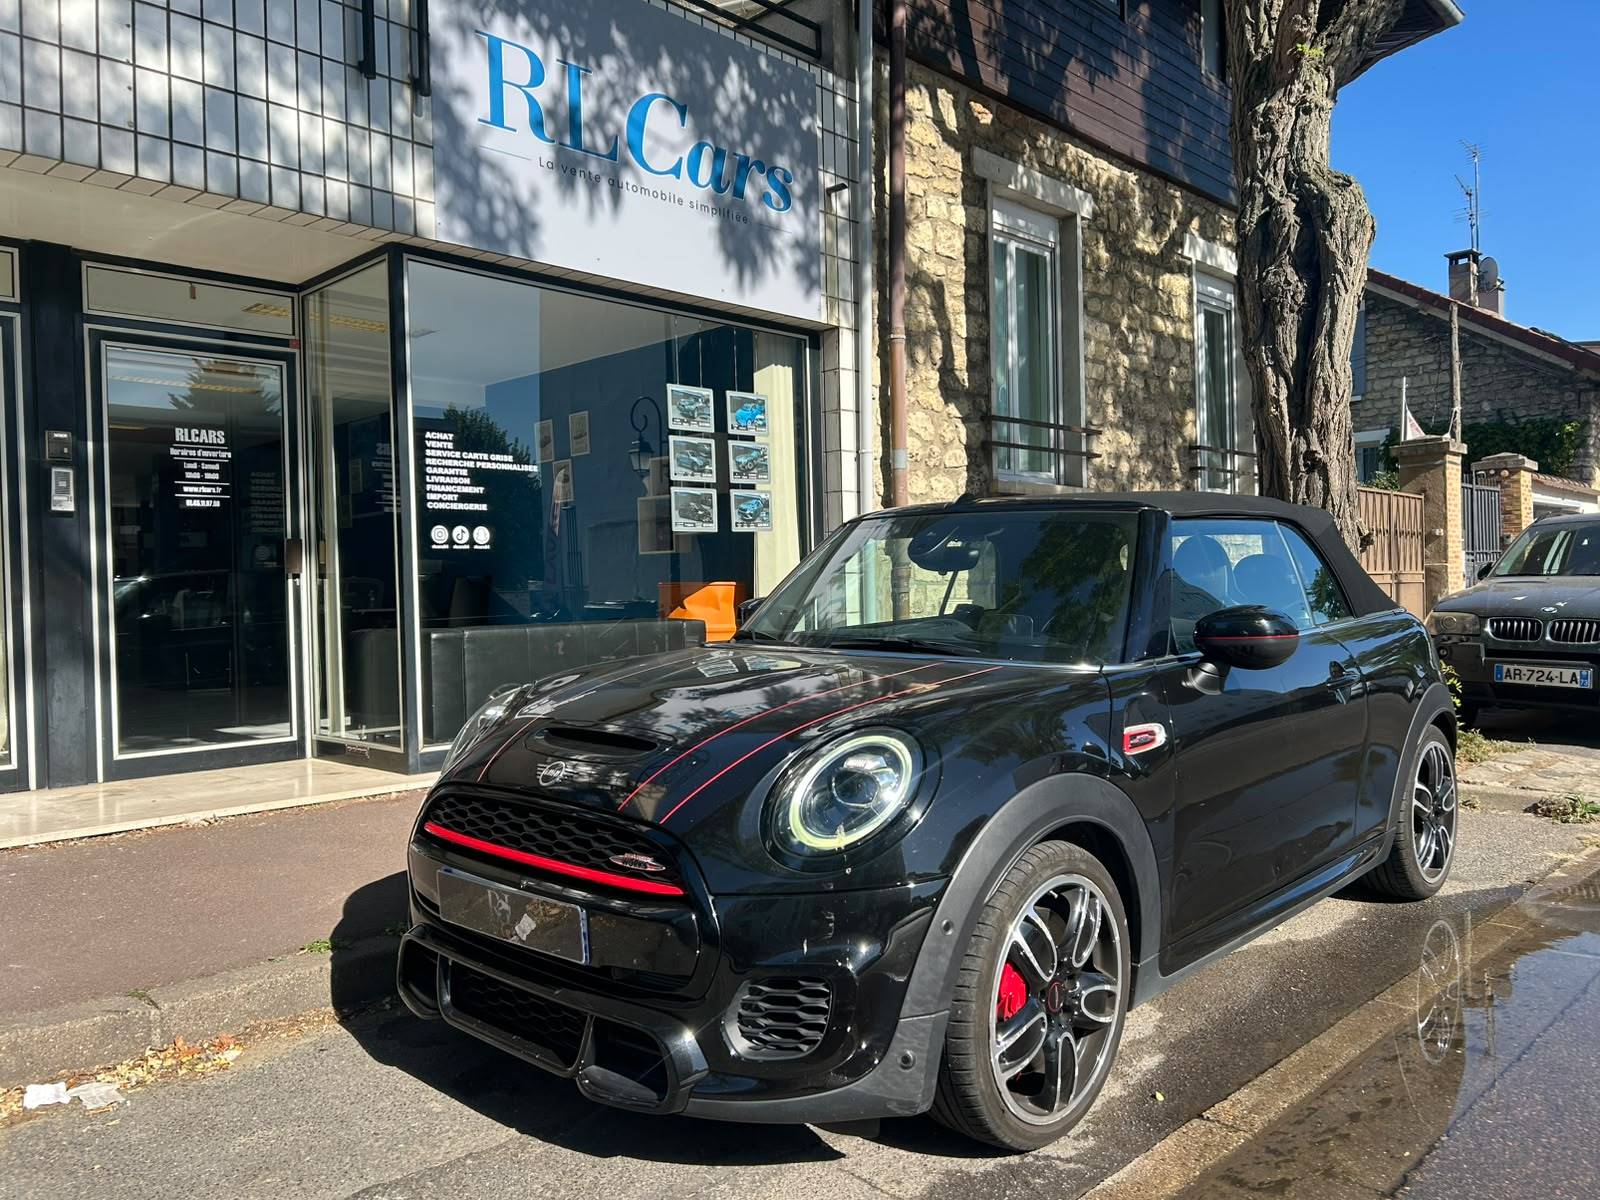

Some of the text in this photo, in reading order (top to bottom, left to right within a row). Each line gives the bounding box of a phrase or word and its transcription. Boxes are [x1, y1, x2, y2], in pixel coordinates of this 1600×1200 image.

[539, 156, 554, 170] La
[561, 162, 601, 184] vente
[607, 176, 684, 206] automobile
[175, 427, 225, 444] RLCARS
[425, 431, 454, 440] ACHAT
[425, 440, 453, 449] VENTE
[169, 447, 197, 456] Horaires
[425, 449, 513, 462] SERVICE CARTE GRISE
[425, 458, 475, 468] RECHERCHE
[426, 467, 468, 476] GARANTIE
[426, 475, 471, 485] LIVRAISON
[426, 484, 485, 494] FINANCEMENT
[426, 493, 459, 501] IMPORT
[427, 501, 488, 511] CONCIERGERIE
[1504, 668, 1578, 685] AR-724-LA
